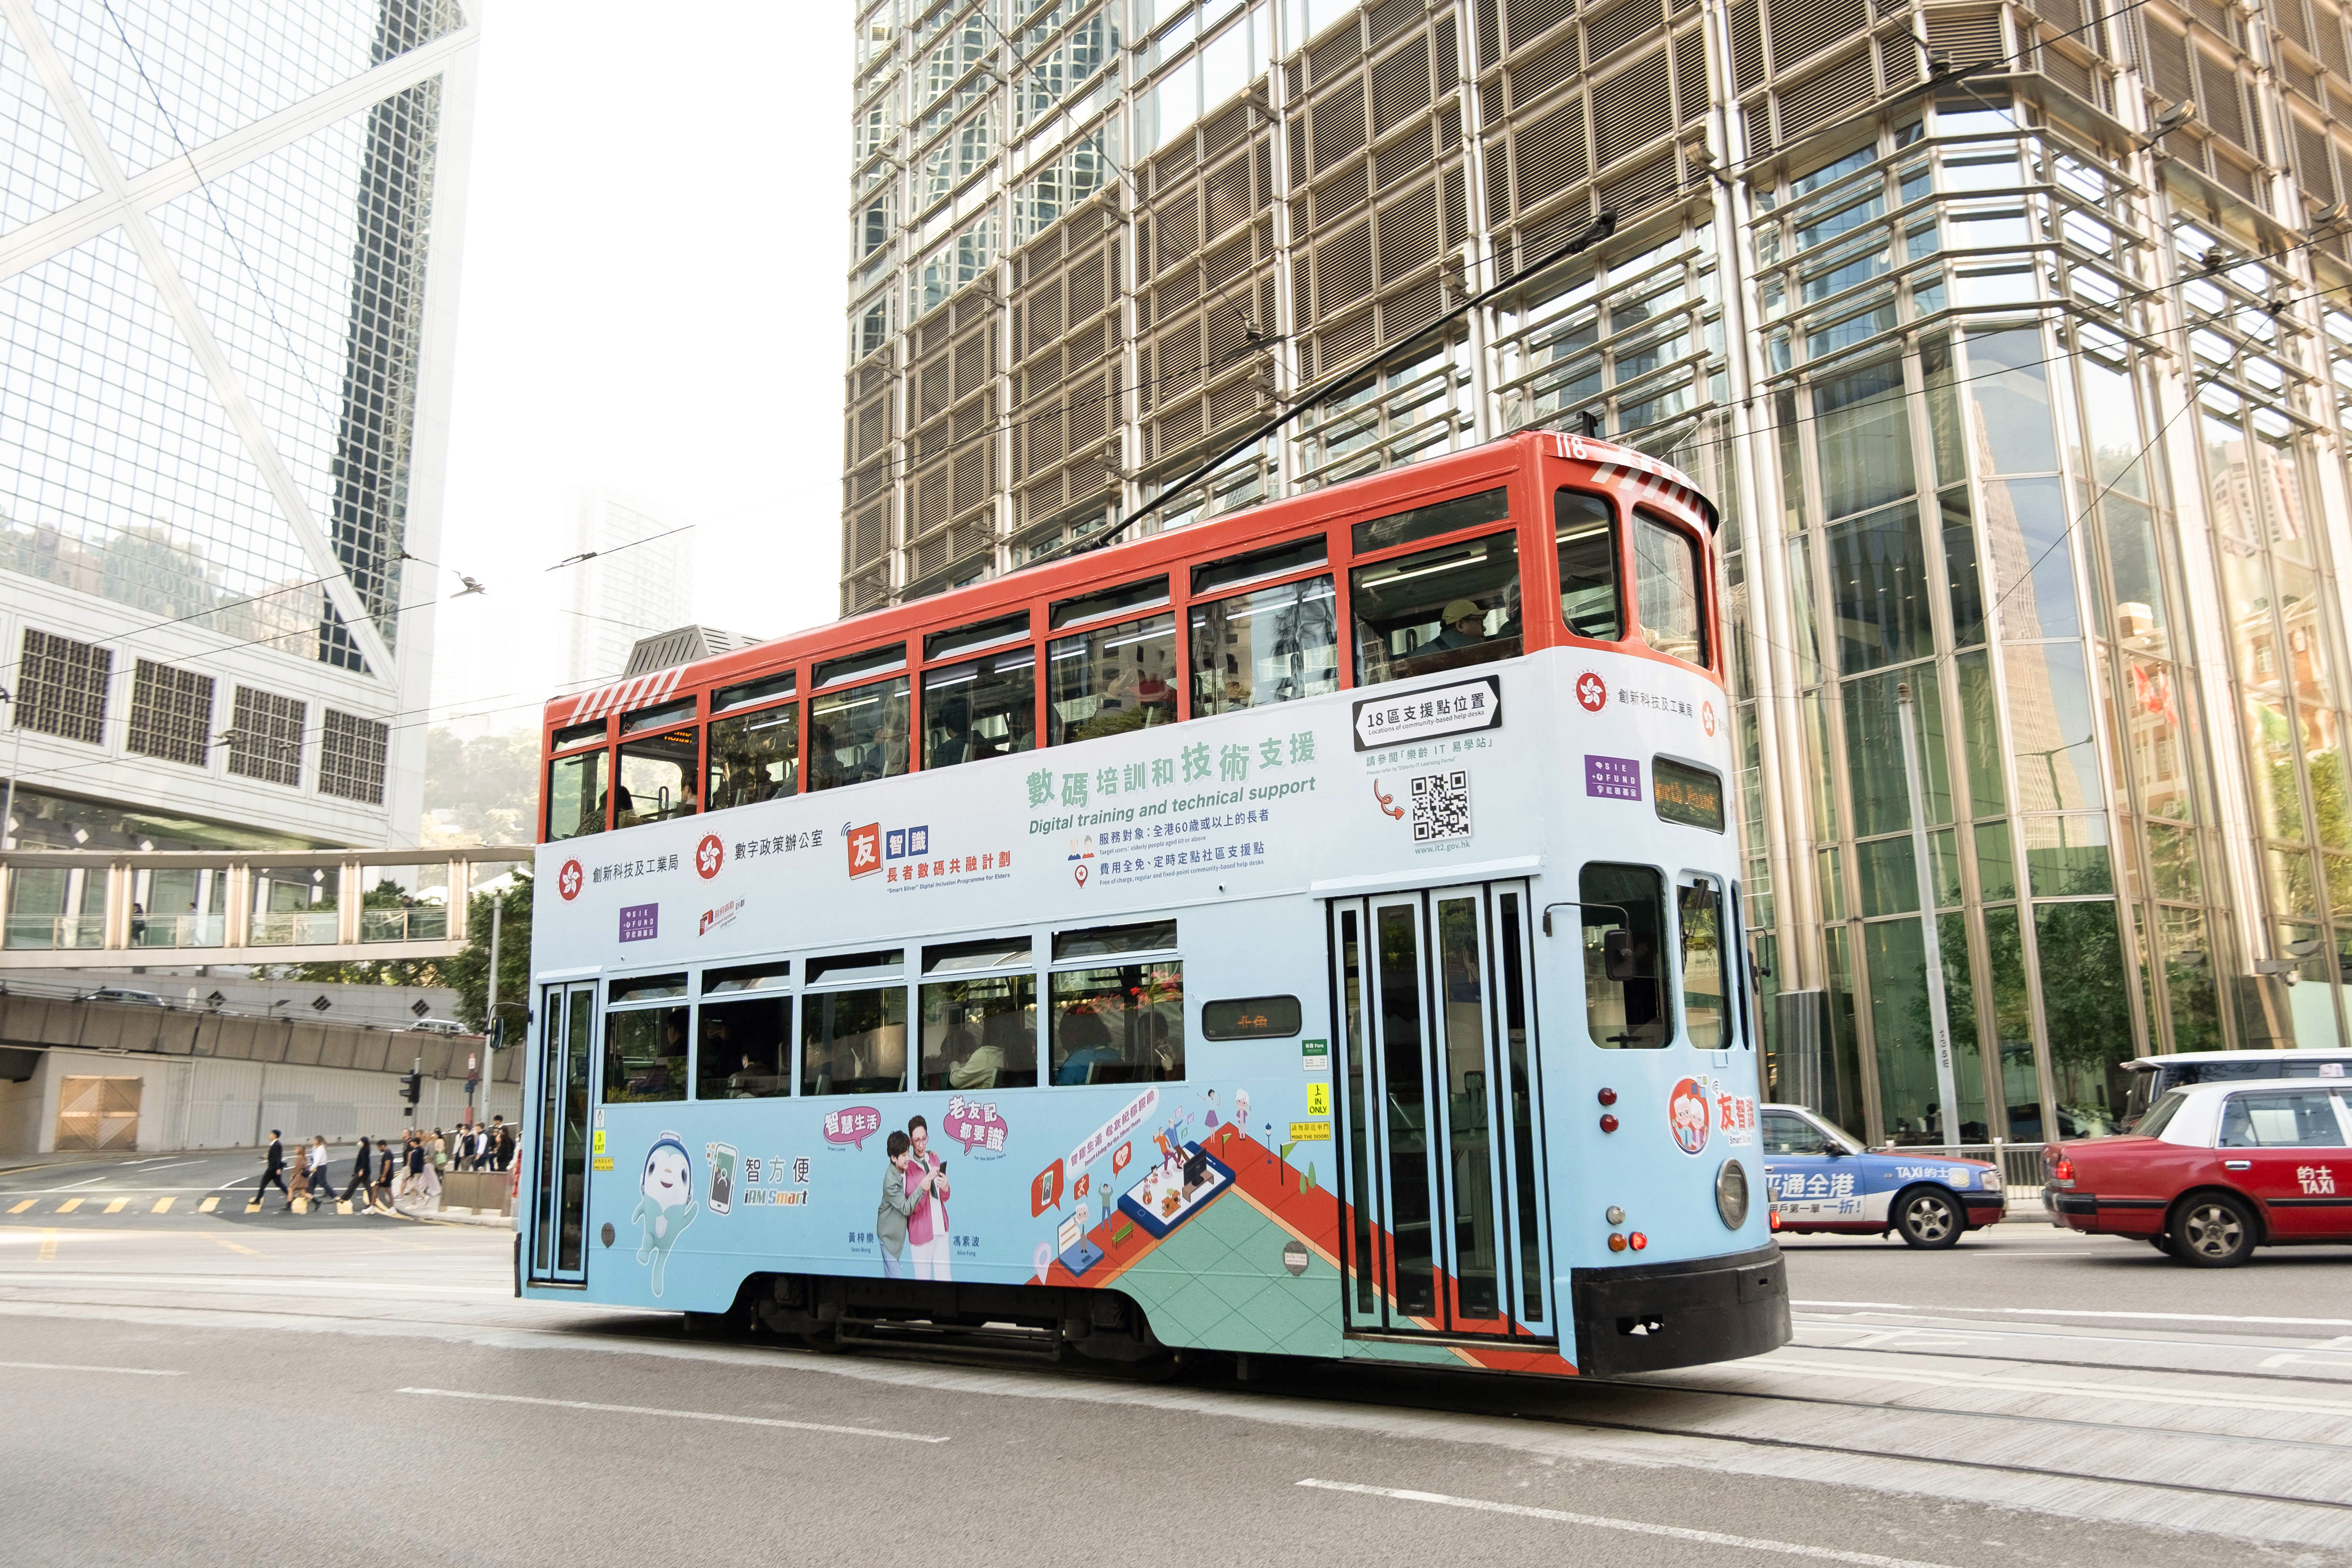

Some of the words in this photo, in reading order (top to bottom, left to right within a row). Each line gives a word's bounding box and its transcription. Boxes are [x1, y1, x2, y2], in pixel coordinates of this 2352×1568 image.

[1556, 434, 1587, 460] 118
[1367, 692, 1485, 727] 18區支援點位置
[1618, 688, 1693, 718] 創新科技及工業局
[1368, 727, 1394, 735] Locations
[1402, 716, 1452, 729] community-based
[1366, 748, 1428, 767] 請參閱「樂齡
[1435, 745, 1445, 755] IT
[1452, 737, 1493, 752] 易學站」
[1421, 759, 1440, 767] Learning
[1026, 730, 1315, 809] 數碼培訓和技術支援
[1605, 762, 1627, 772] SIE
[1606, 775, 1635, 785] FUND
[1029, 814, 1074, 836] Digital
[1077, 807, 1134, 828] training
[1139, 799, 1167, 818] and
[1172, 788, 1243, 812] technical
[1248, 777, 1316, 804] support
[1099, 809, 1269, 846] 服務對象：全港60歲或以上的長者
[735, 830, 823, 860] 數字政策辦公室
[1415, 840, 1470, 854] www.it2.gov.hk
[593, 854, 678, 884] 創新科技及工業局
[887, 851, 1010, 883] 長者數碼共融計劃
[1099, 842, 1264, 876] 費用全免、定時定點社區支援點
[1135, 874, 1152, 882] regular
[1163, 868, 1189, 877] fixed-point
[1190, 862, 1236, 874] community-based
[957, 876, 985, 885] Programme
[633, 909, 648, 918] SIE
[633, 918, 653, 927] FUND
[949, 1095, 997, 1124] 老友記
[825, 1110, 877, 1136] 智慧生活
[960, 1123, 1004, 1152] 都要識
[745, 1157, 810, 1183] 智方便
[1895, 1166, 1923, 1178] TAXI
[1924, 1166, 1949, 1178] 的士
[2296, 1166, 2332, 1180] 的士
[768, 1190, 807, 1205] Smart
[2299, 1179, 2335, 1194] TAXI
[954, 1235, 979, 1247] 馮素波
